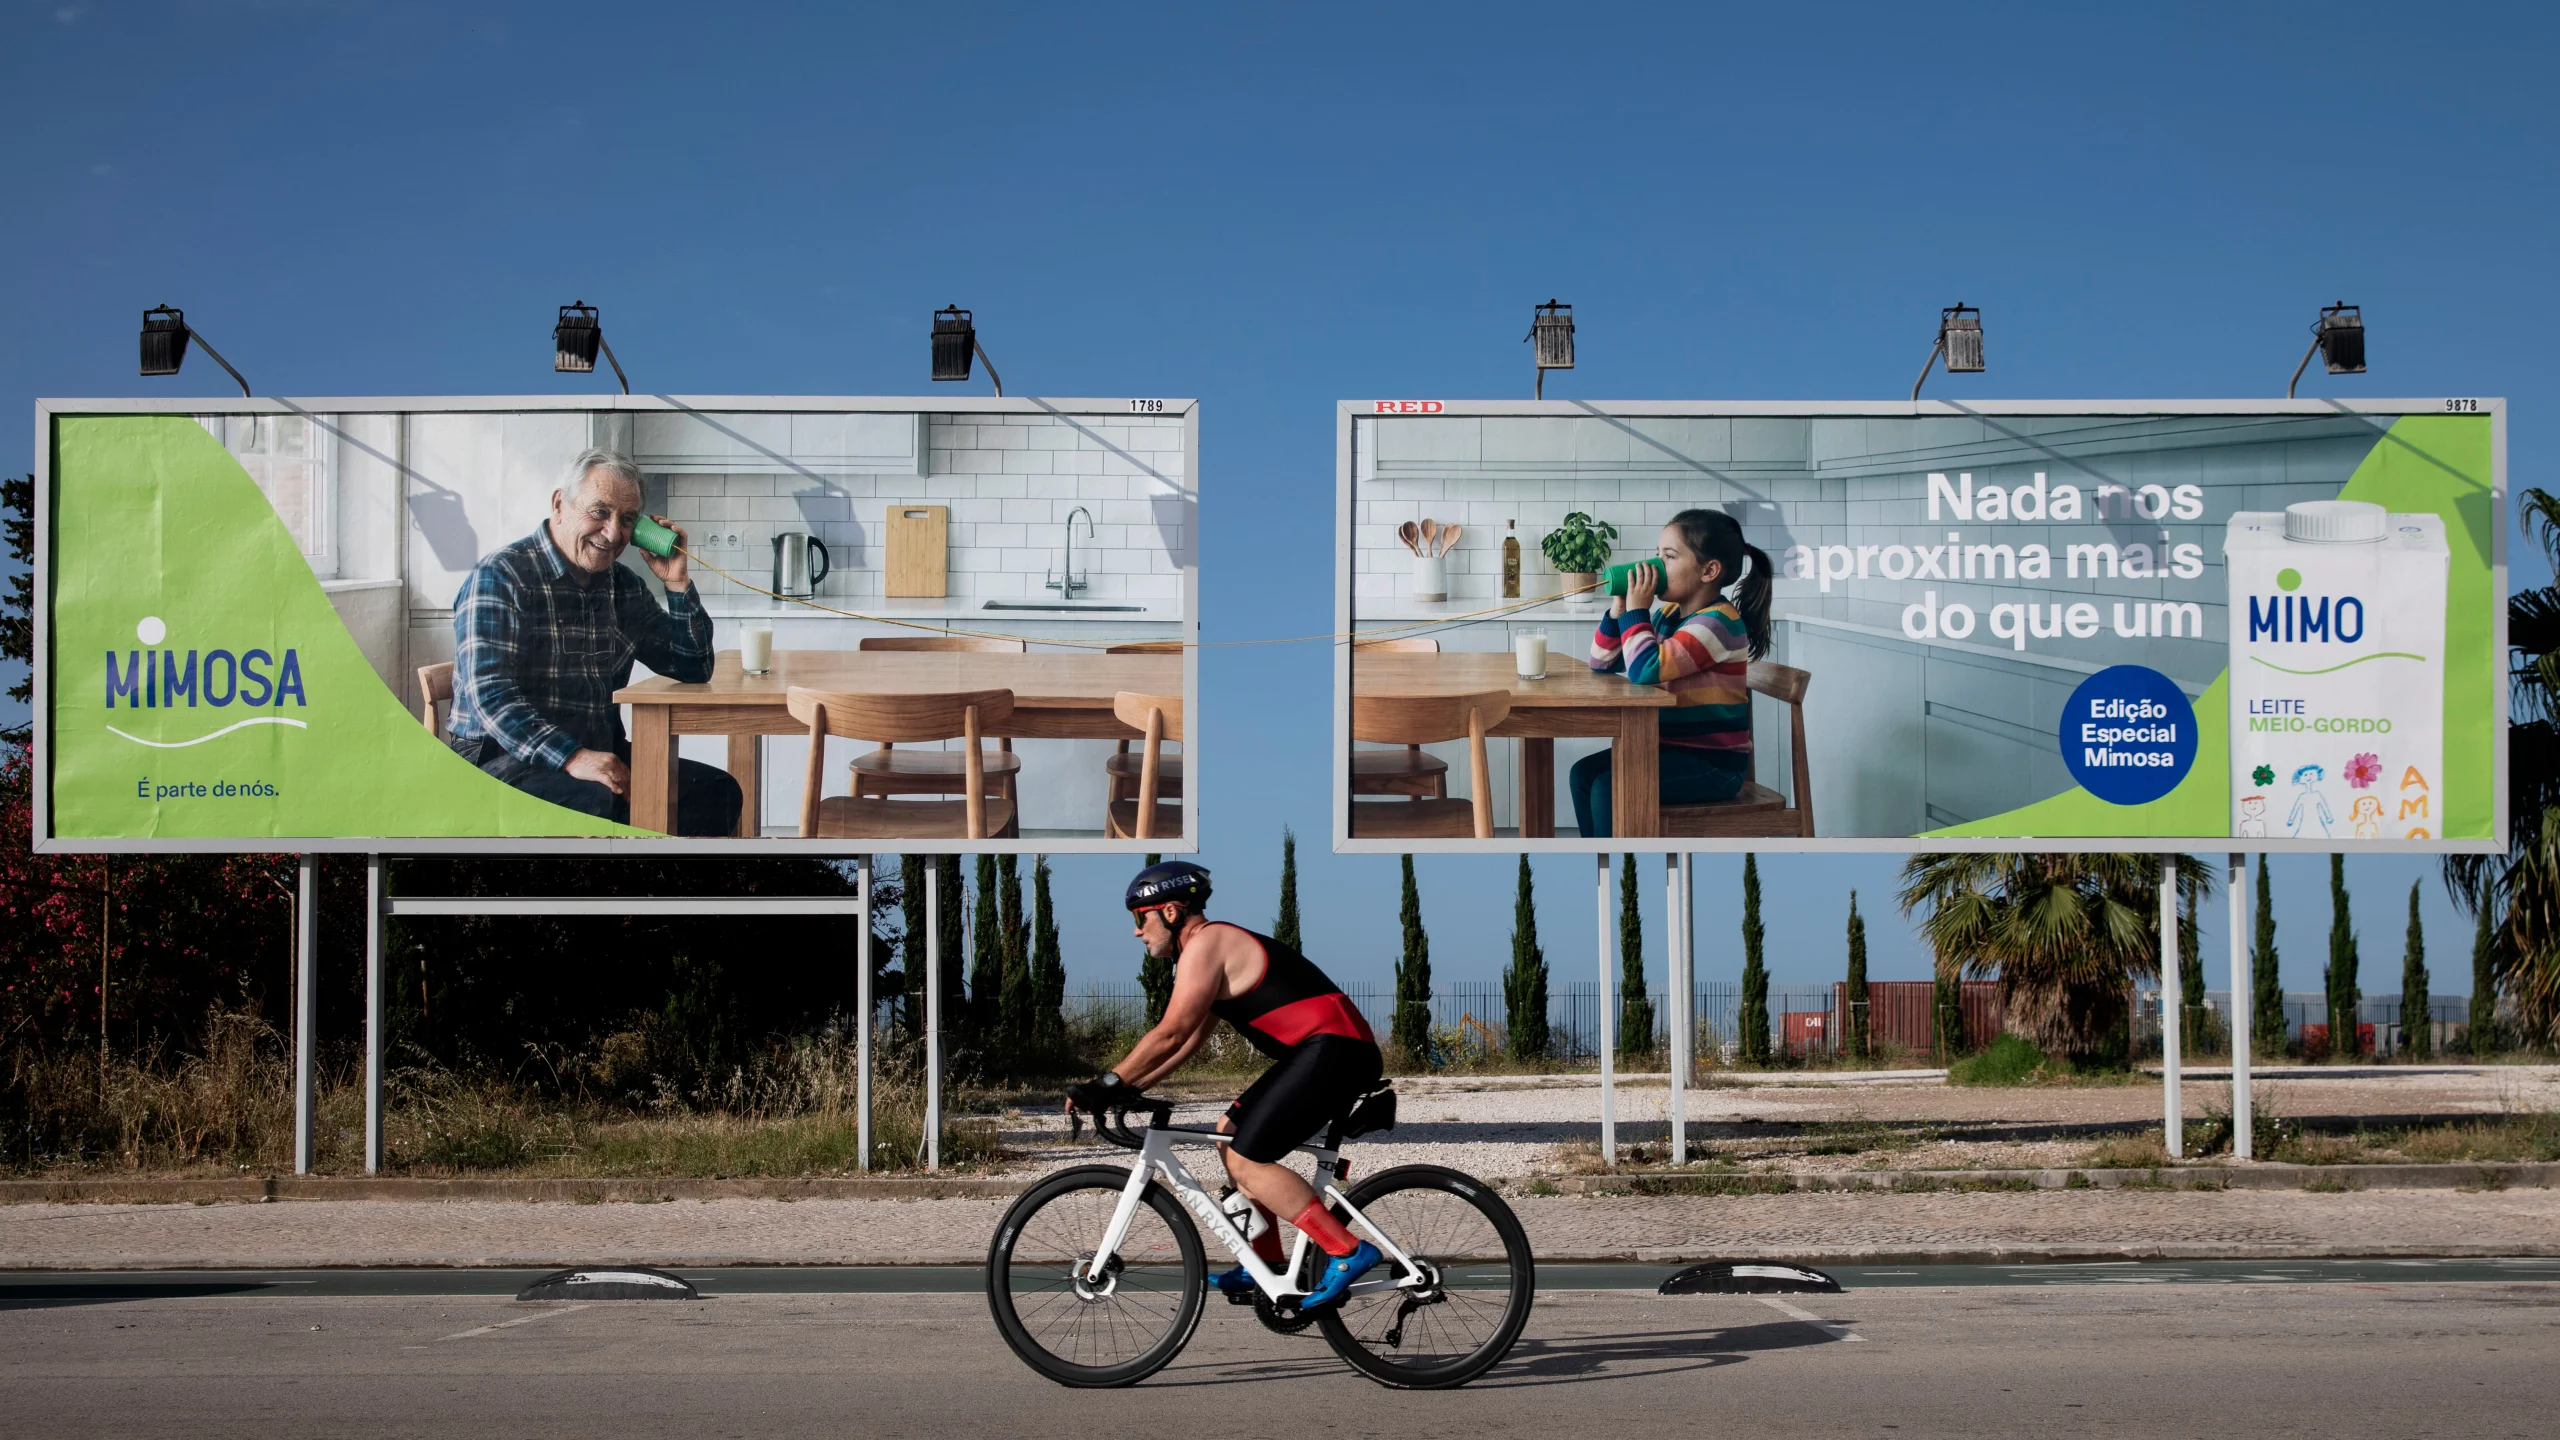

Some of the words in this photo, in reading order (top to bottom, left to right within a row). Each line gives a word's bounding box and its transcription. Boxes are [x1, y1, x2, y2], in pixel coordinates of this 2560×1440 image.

[1131, 399, 1163, 412] 1789
[1375, 401, 1443, 413] RED
[2446, 399, 2477, 412] 9878
[1927, 472, 2082, 521] Nada
[2098, 484, 2203, 521] nos
[1783, 532, 2051, 593] aproxima
[2067, 530, 2203, 580] mais
[2249, 568, 2363, 643] MIMO
[1902, 591, 1976, 640] do
[1989, 602, 2100, 651] que
[2113, 602, 2203, 639] um
[106, 616, 307, 709] MIMOSA
[2091, 699, 2168, 723] Edição
[2250, 699, 2306, 715] LEITE
[2081, 723, 2176, 747] Especial
[2249, 717, 2392, 734] MEIO-GORDO
[2085, 747, 2174, 767] Mimosa
[138, 776, 150, 798] É
[156, 781, 207, 802] parte
[212, 780, 236, 797] de
[240, 779, 279, 797] nós.
[1136, 884, 1160, 898] VAN
[1161, 874, 1197, 891] RYSEL
[1175, 1174, 1204, 1210] VAN
[1202, 1209, 1245, 1256] RYSEL
